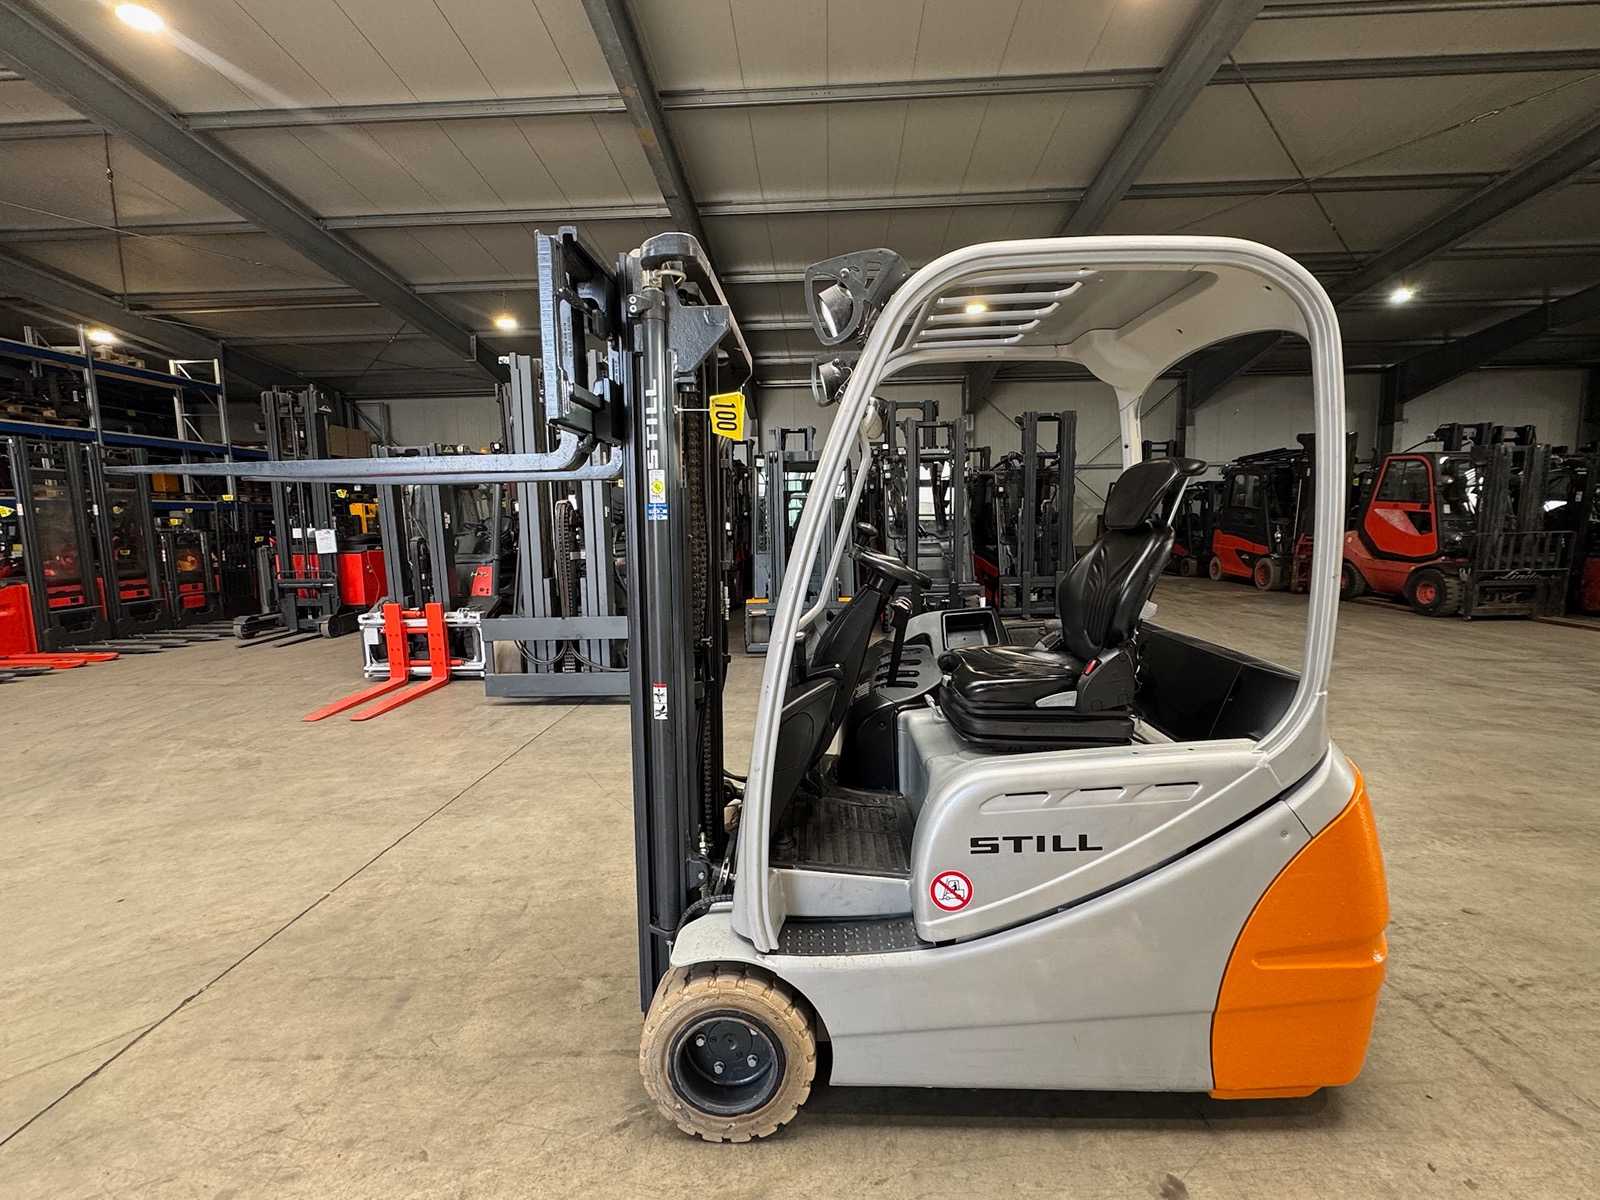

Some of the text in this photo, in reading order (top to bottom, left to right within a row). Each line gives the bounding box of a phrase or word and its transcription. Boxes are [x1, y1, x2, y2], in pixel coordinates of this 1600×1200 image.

[645, 379, 659, 469] STILL
[715, 403, 737, 431] 100
[970, 834, 1103, 854] STILL
